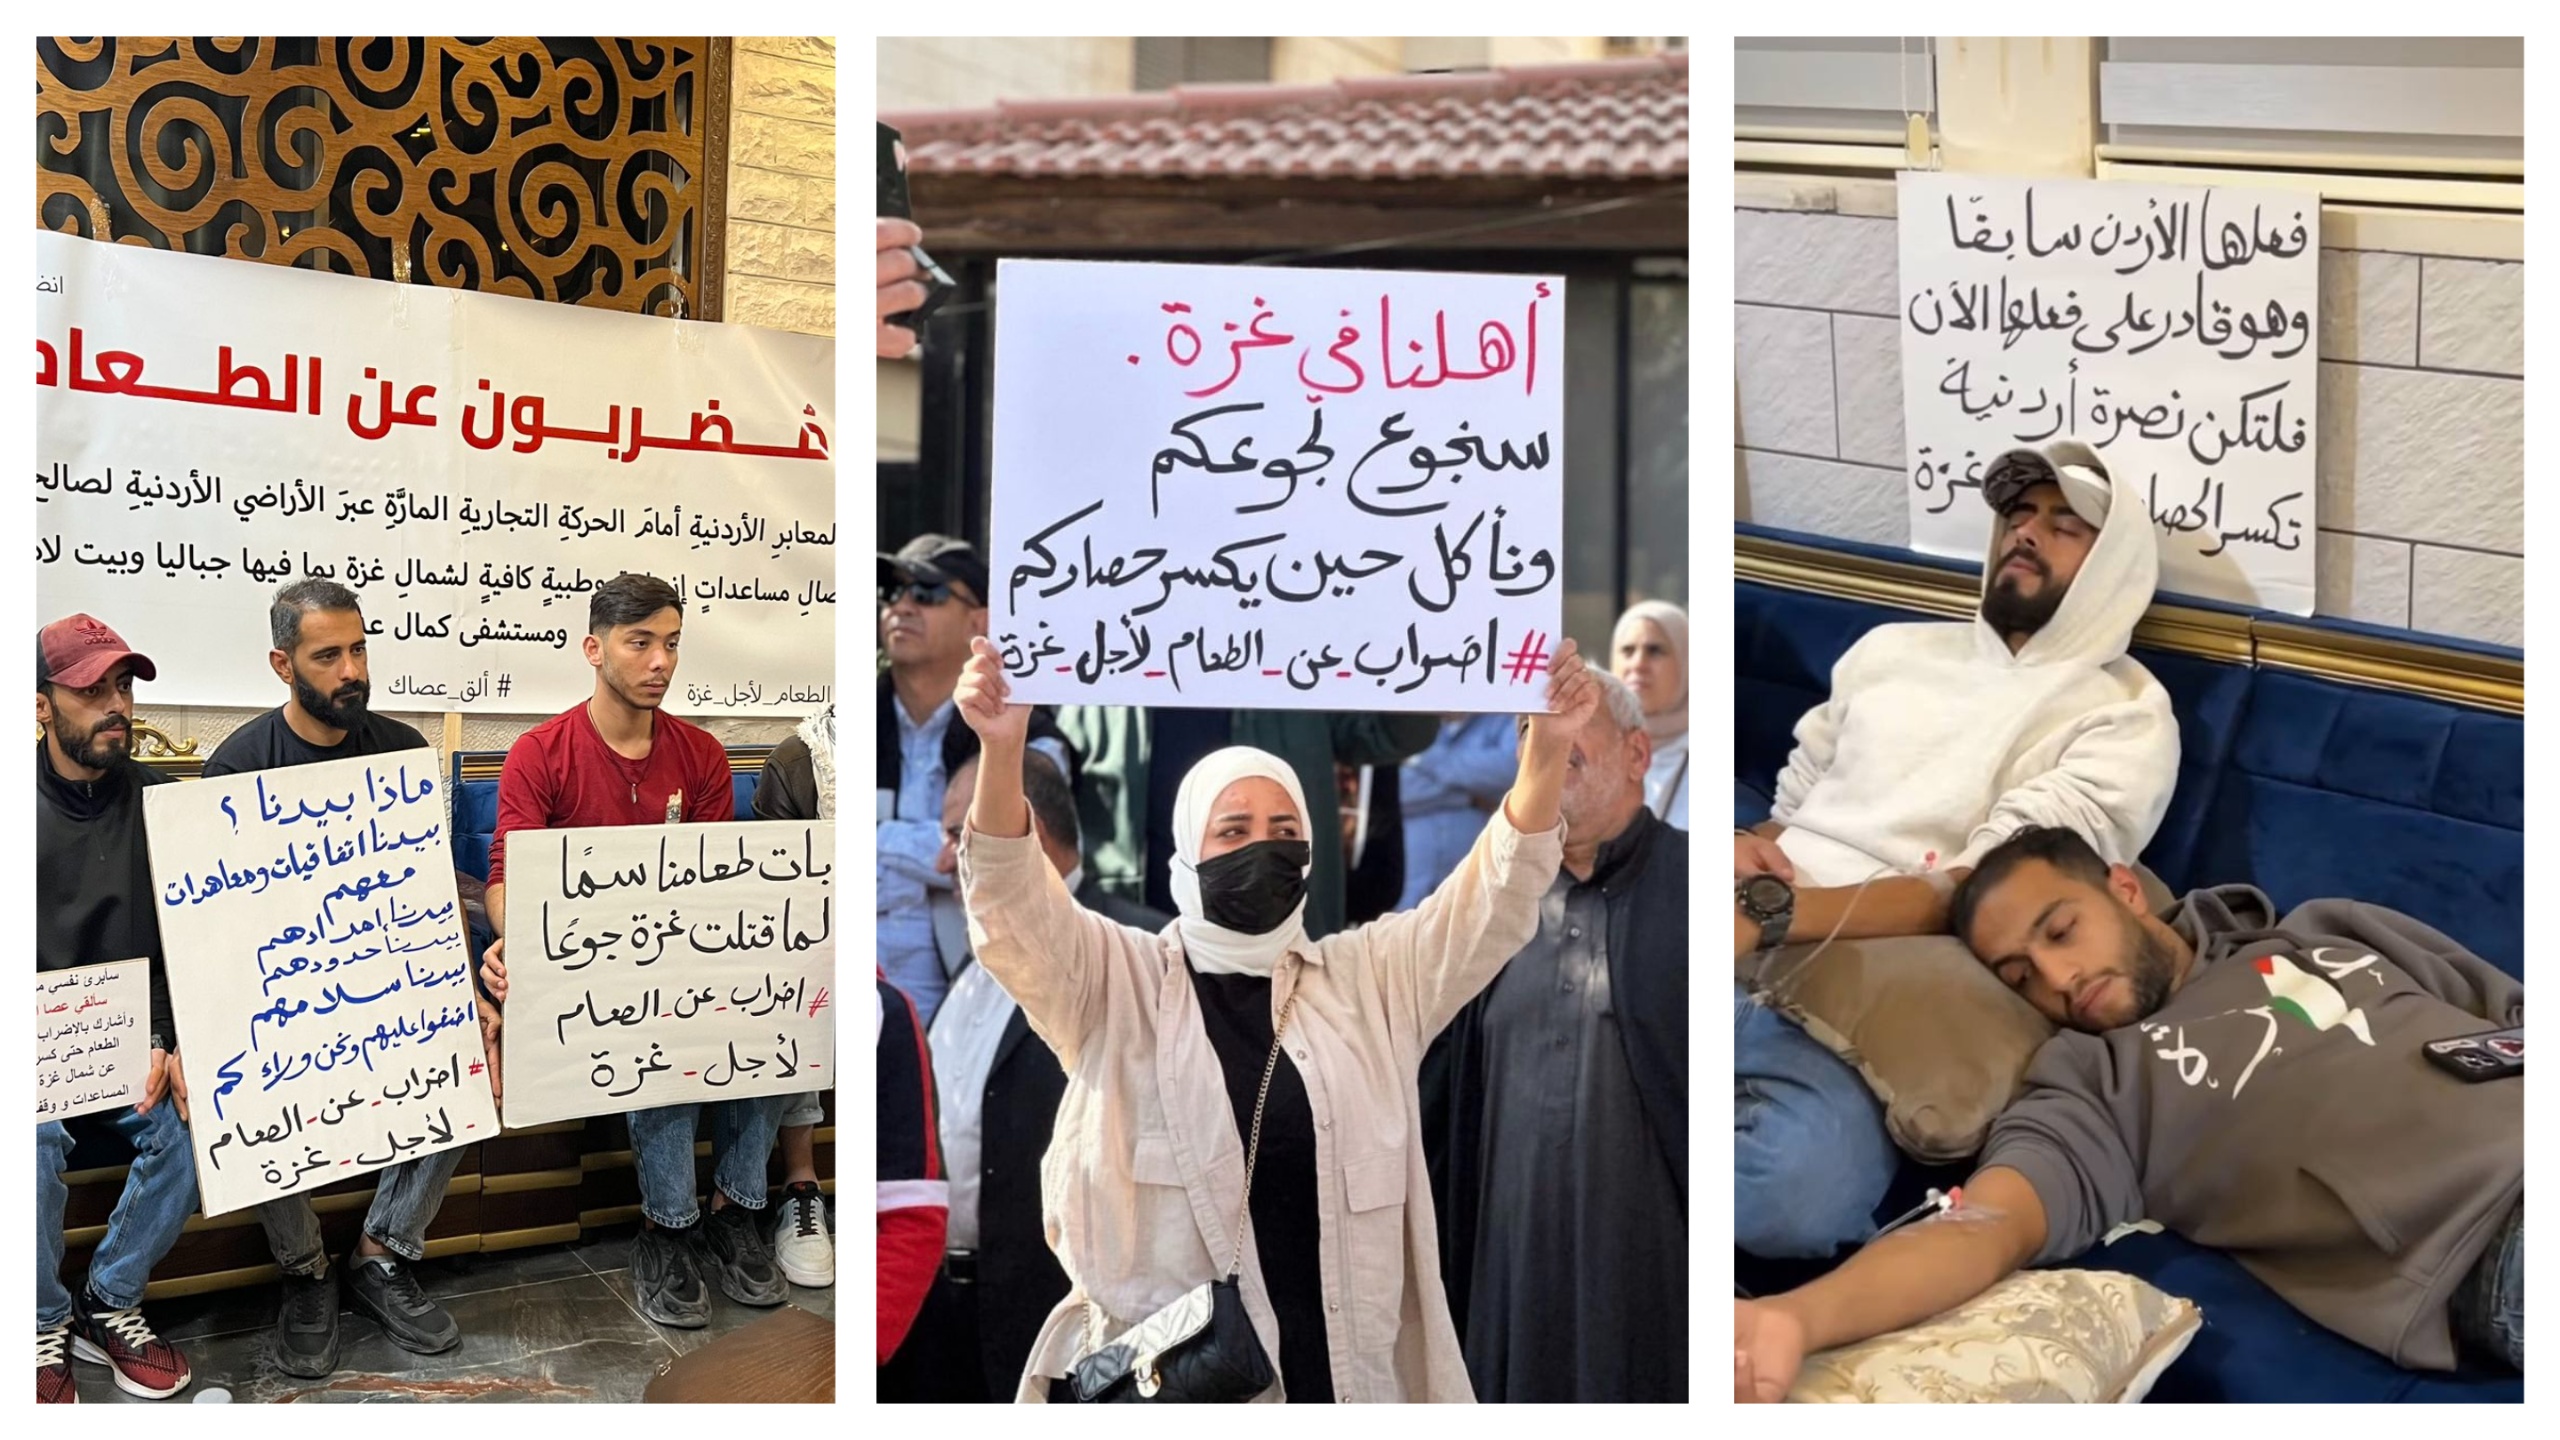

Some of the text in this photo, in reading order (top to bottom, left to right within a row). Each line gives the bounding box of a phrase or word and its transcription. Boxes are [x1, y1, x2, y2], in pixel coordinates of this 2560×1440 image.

[2091, 198, 2189, 275] الأردن
[2201, 188, 2307, 270] فعلها
[1382, 281, 1551, 396] أهلنا
[2000, 274, 2083, 351] فعلها
[2071, 292, 2153, 353] على
[2128, 270, 2233, 355] قادر
[2218, 299, 2310, 360] وهو
[1299, 309, 1366, 403] في
[347, 367, 437, 440] عن
[1939, 357, 2306, 465] فلتكن نصرة أردنية
[1152, 402, 1551, 518] سنجوع لجوعكم
[233, 478, 325, 522] الأراضي
[2141, 472, 2224, 536] الحصا
[2198, 491, 2304, 557] تكسر
[74, 541, 145, 575] وبيت
[156, 542, 231, 581] جباليا
[242, 548, 292, 583] فيها
[346, 555, 385, 588] غزة
[1009, 499, 1555, 615] ونأكل حين يكسر حصاركم
[394, 612, 452, 640] كمال
[459, 618, 568, 650] ومستشفى
[257, 775, 355, 828] بيدنا
[366, 766, 434, 812] ماذا
[370, 818, 442, 852] بيدنا
[658, 833, 755, 892] طعامنا
[758, 828, 832, 885] بات
[323, 866, 416, 925] معهم
[390, 896, 454, 928] بيدنا
[631, 909, 685, 966] غزة
[689, 910, 775, 953] قتلت
[783, 896, 830, 952] لما
[48, 974, 79, 995] نفسي
[263, 932, 461, 997] بيدنا حدودهم
[43, 1002, 69, 1014] عصا
[74, 993, 108, 1014] سألقي
[93, 1011, 134, 1031] وأشارك
[251, 960, 466, 1052] بيدنا سلامهم
[88, 1036, 119, 1057] الطعام
[315, 1032, 359, 1071] ونحن
[362, 1016, 419, 1072] عليهم
[39, 1063, 115, 1087] عن شمال غزة
[72, 1083, 129, 1105] المساعدات
